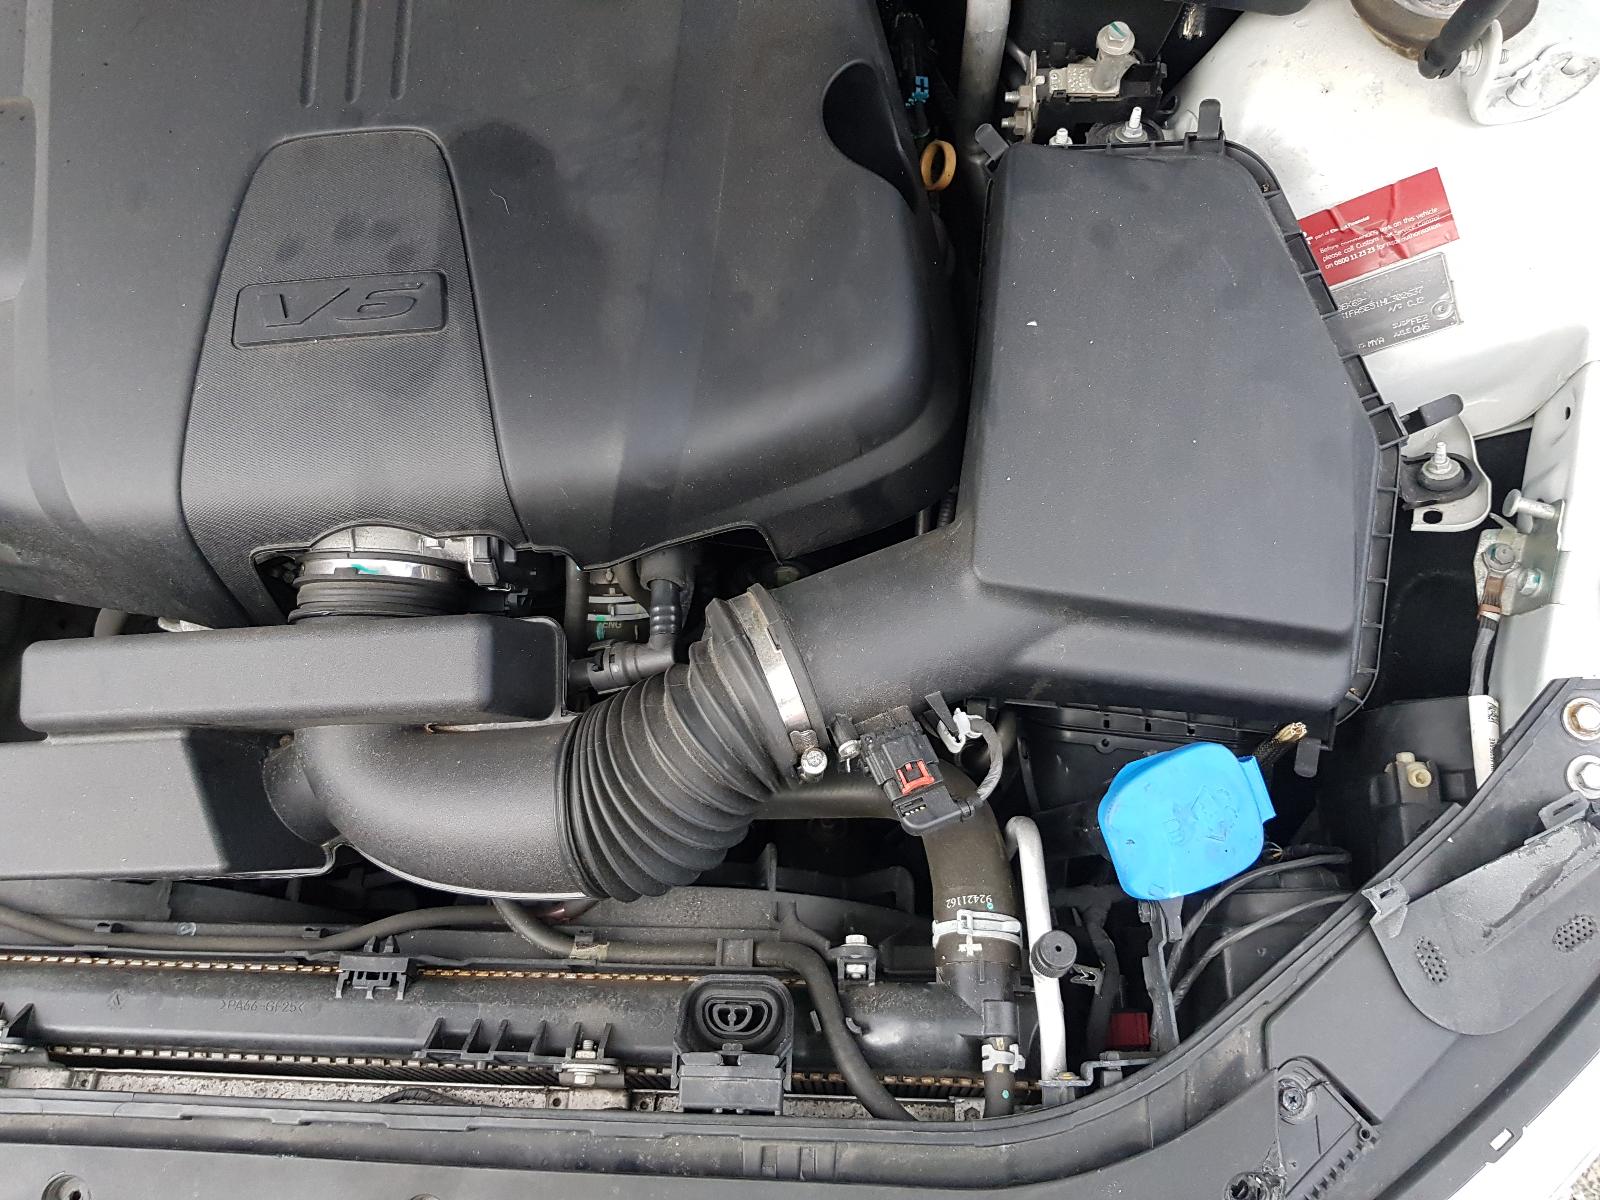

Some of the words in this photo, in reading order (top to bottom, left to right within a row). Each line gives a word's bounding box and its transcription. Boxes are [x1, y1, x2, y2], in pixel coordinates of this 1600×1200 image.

[1320, 244, 1340, 254] Before
[1322, 252, 1342, 262] please
[1343, 245, 1355, 254] call
[1355, 237, 1380, 249] Custom
[1325, 262, 1334, 270] on
[1333, 256, 1350, 266] 0800
[1350, 252, 1359, 261] 11
[1358, 249, 1367, 258] 23
[1367, 246, 1376, 254] 23
[1376, 242, 1385, 250] for
[257, 281, 425, 328] V6
[945, 894, 993, 909] 92421162
